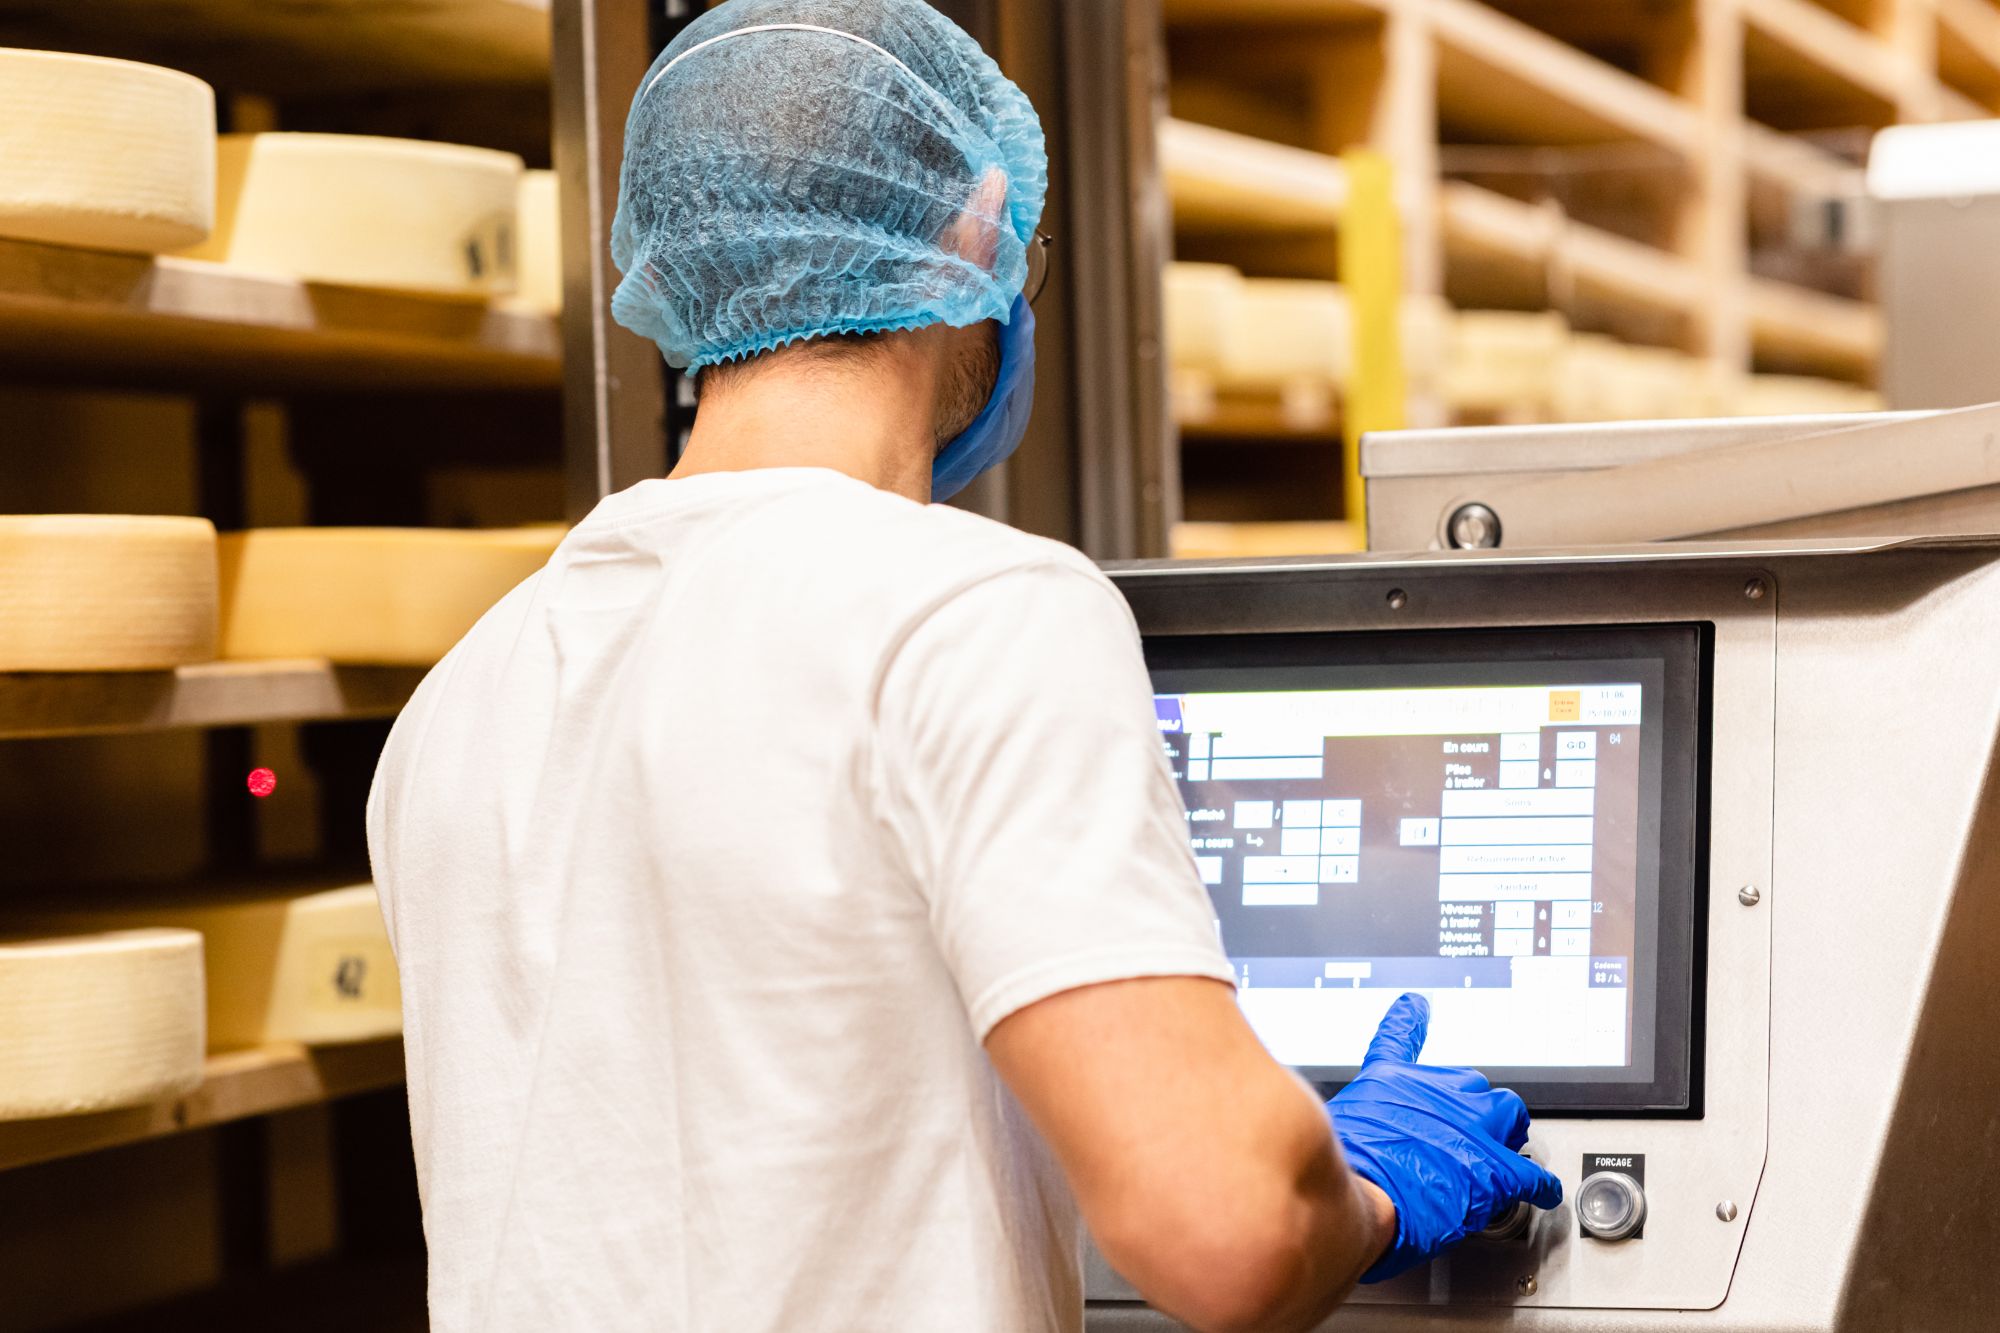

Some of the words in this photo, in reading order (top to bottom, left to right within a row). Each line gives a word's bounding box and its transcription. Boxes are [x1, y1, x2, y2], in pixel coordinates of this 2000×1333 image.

[1443, 741, 1459, 754] En
[1460, 741, 1489, 754] cours
[1441, 902, 1483, 915] Niveaux
[1592, 902, 1603, 913] 12
[1595, 1157, 1632, 1168] FORCAGE
